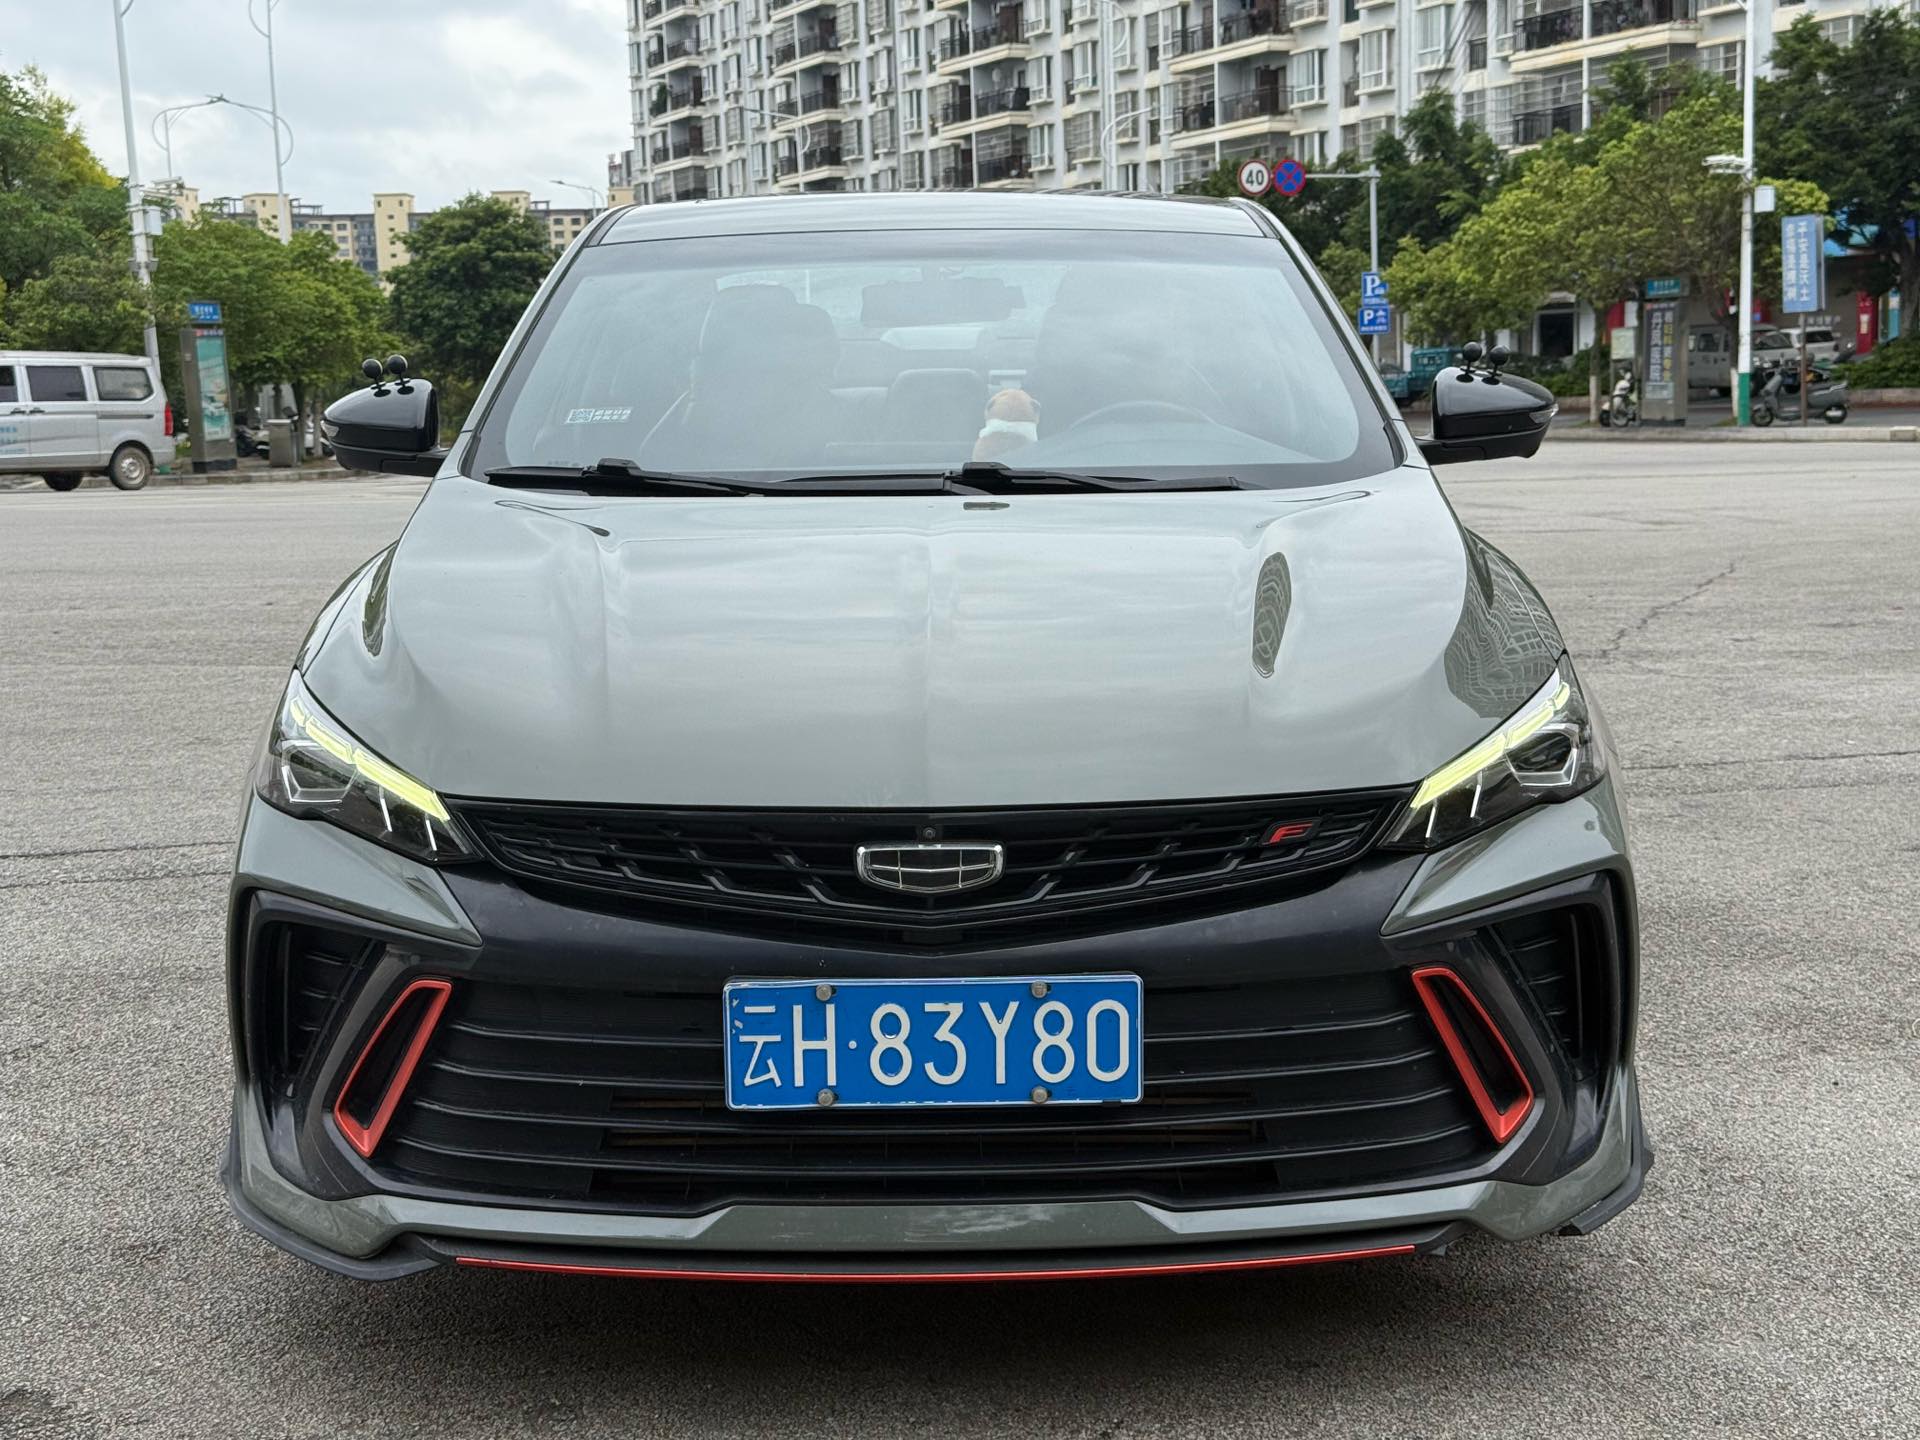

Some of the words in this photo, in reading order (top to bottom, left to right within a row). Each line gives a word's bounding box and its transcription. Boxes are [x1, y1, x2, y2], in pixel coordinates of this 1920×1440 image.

[1246, 170, 1264, 186] 40
[1364, 275, 1380, 297] P
[1363, 310, 1374, 325] P
[1269, 820, 1313, 843] F
[738, 999, 1130, 1088] 云H·83Y80
